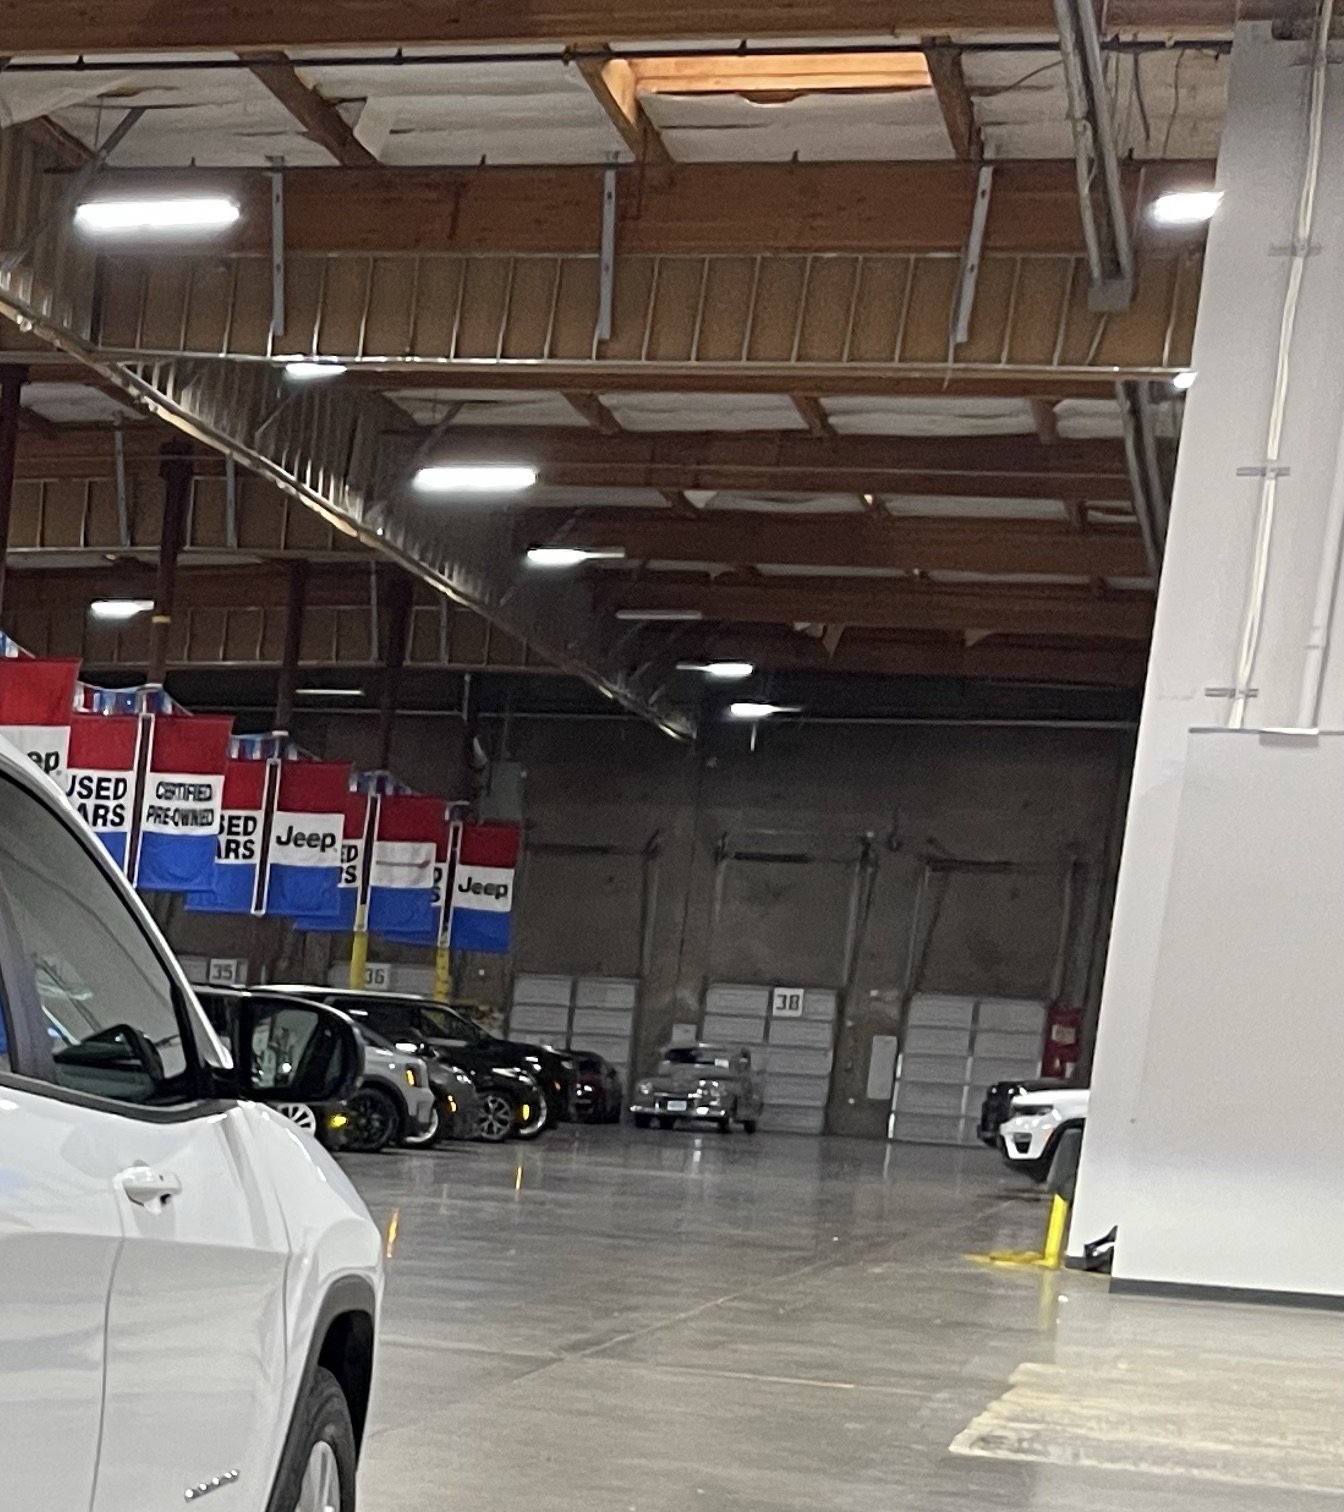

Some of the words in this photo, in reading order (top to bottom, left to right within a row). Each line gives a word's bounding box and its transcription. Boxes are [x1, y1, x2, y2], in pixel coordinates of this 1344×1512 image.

[27, 751, 60, 774] ep
[155, 781, 213, 802] CERTIFIED
[76, 803, 126, 827] ARS
[146, 804, 215, 827] PRE-OWNED
[276, 825, 337, 853] Jeep
[458, 876, 509, 900] Jeep
[212, 964, 233, 981] 35
[776, 994, 801, 1010] 38
